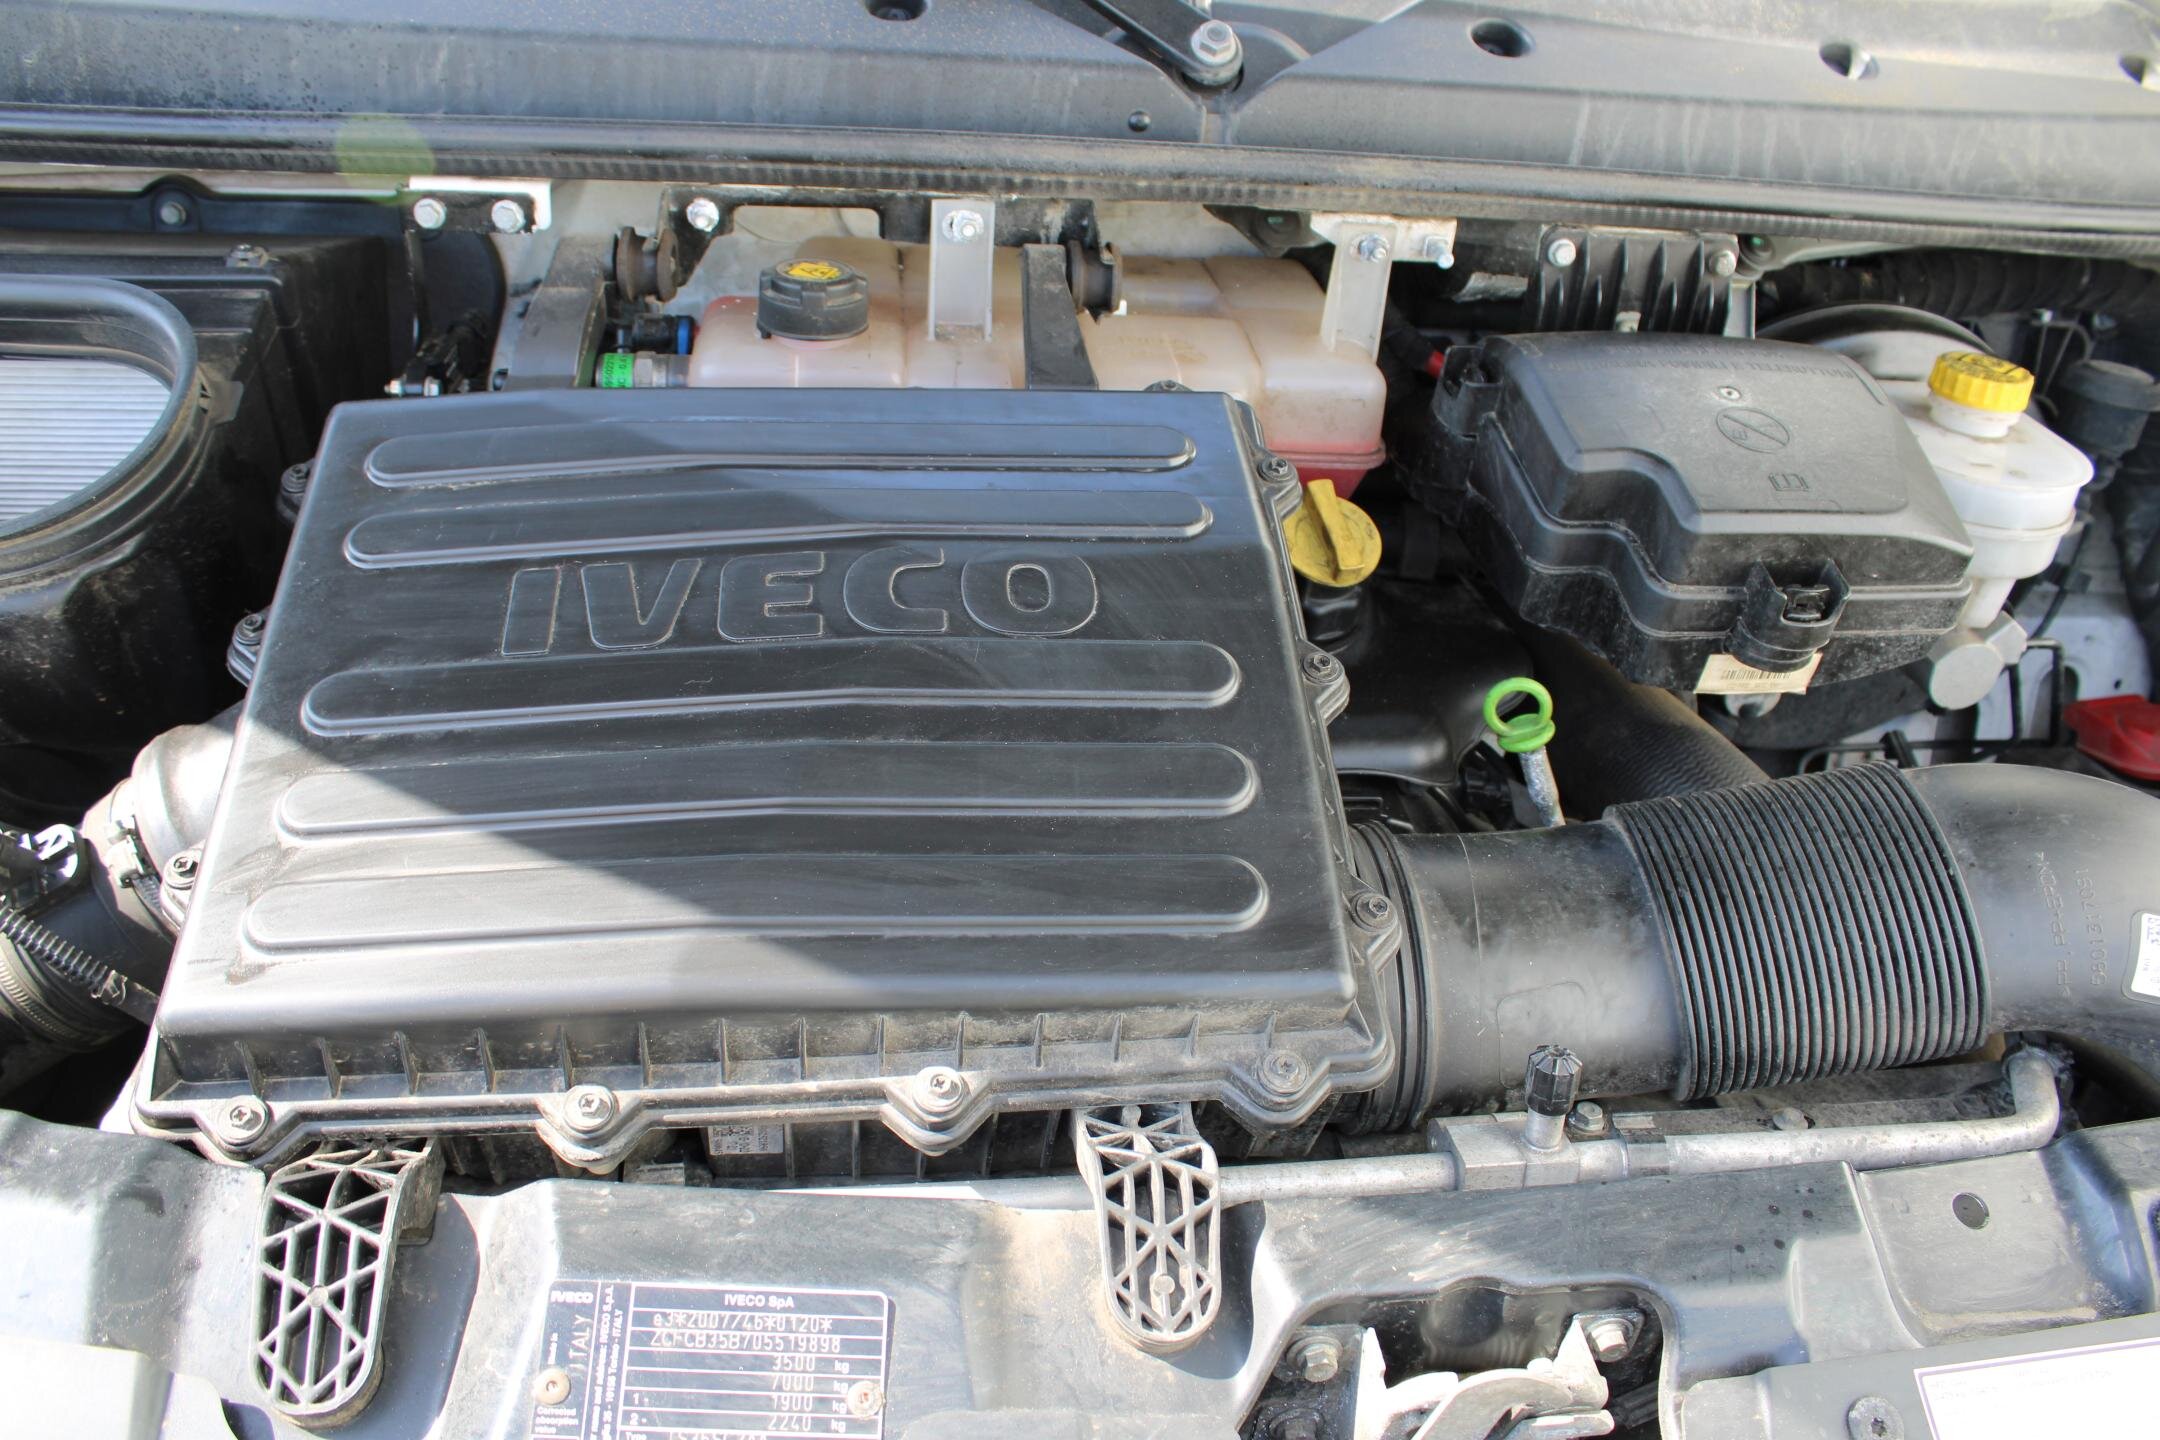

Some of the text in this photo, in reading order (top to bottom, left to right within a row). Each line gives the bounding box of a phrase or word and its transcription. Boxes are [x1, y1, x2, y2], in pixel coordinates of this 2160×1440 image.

[501, 545, 1097, 657] IVECO
[550, 1289, 593, 1304] IVECO
[724, 1293, 796, 1311] IVECO SpA
[599, 1312, 611, 1343] IVECO
[612, 1308, 624, 1337] ITALY
[567, 1313, 594, 1373] ITALY
[608, 1343, 620, 1375] Torino
[772, 1356, 850, 1375] 3500 kg
[771, 1375, 849, 1395] 7000 kg
[536, 1406, 577, 1417] Corrected
[770, 1394, 813, 1412] 1900
[832, 1400, 848, 1415] kg
[768, 1414, 812, 1432] 2240
[831, 1419, 847, 1434] kg
